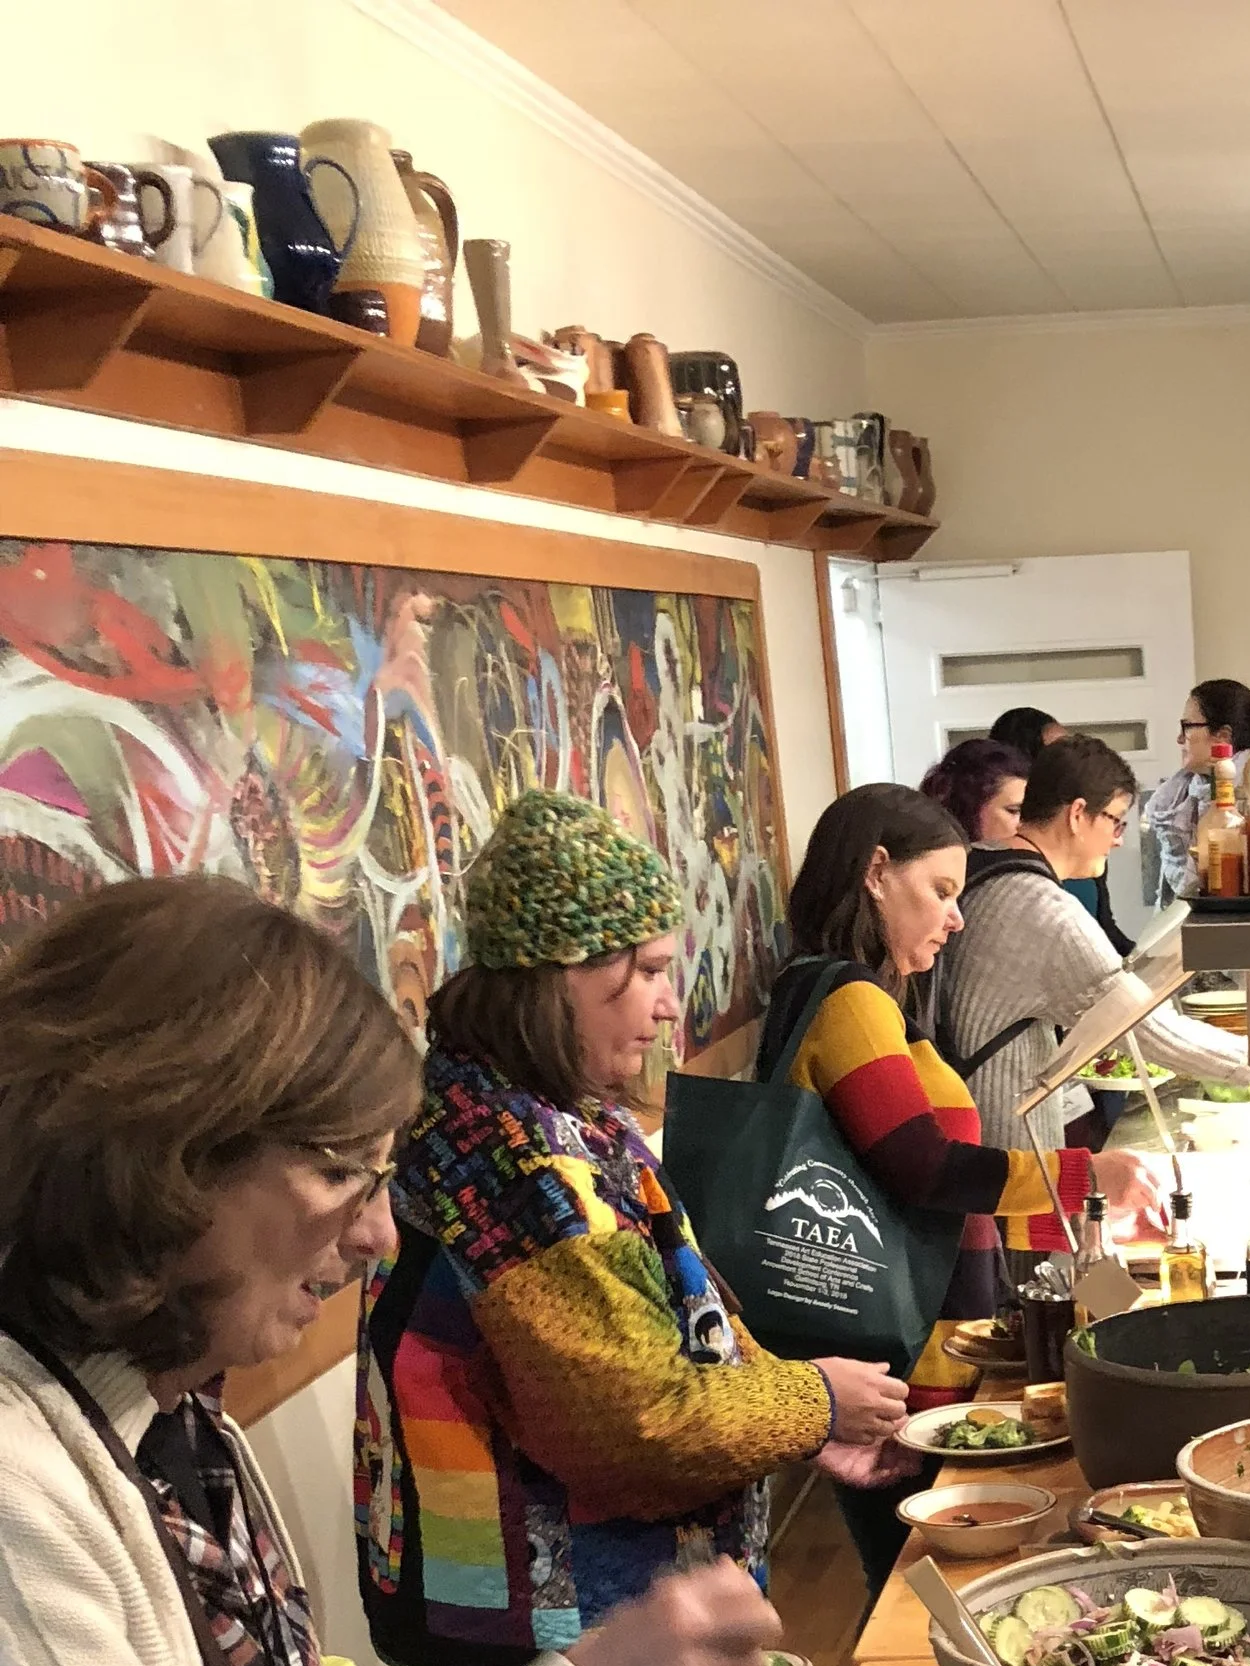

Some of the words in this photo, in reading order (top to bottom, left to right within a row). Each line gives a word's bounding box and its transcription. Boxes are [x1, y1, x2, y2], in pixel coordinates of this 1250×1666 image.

[791, 1217, 859, 1253] TAEA
[780, 1256, 821, 1272] Development
[822, 1267, 858, 1280] Conference
[801, 1254, 818, 1263] State
[811, 1249, 841, 1262] Education
[842, 1258, 877, 1272] Association
[783, 1278, 816, 1291] November
[797, 1268, 819, 1278] School
[827, 1275, 840, 1283] Arts
[855, 1282, 874, 1292] Crafts
